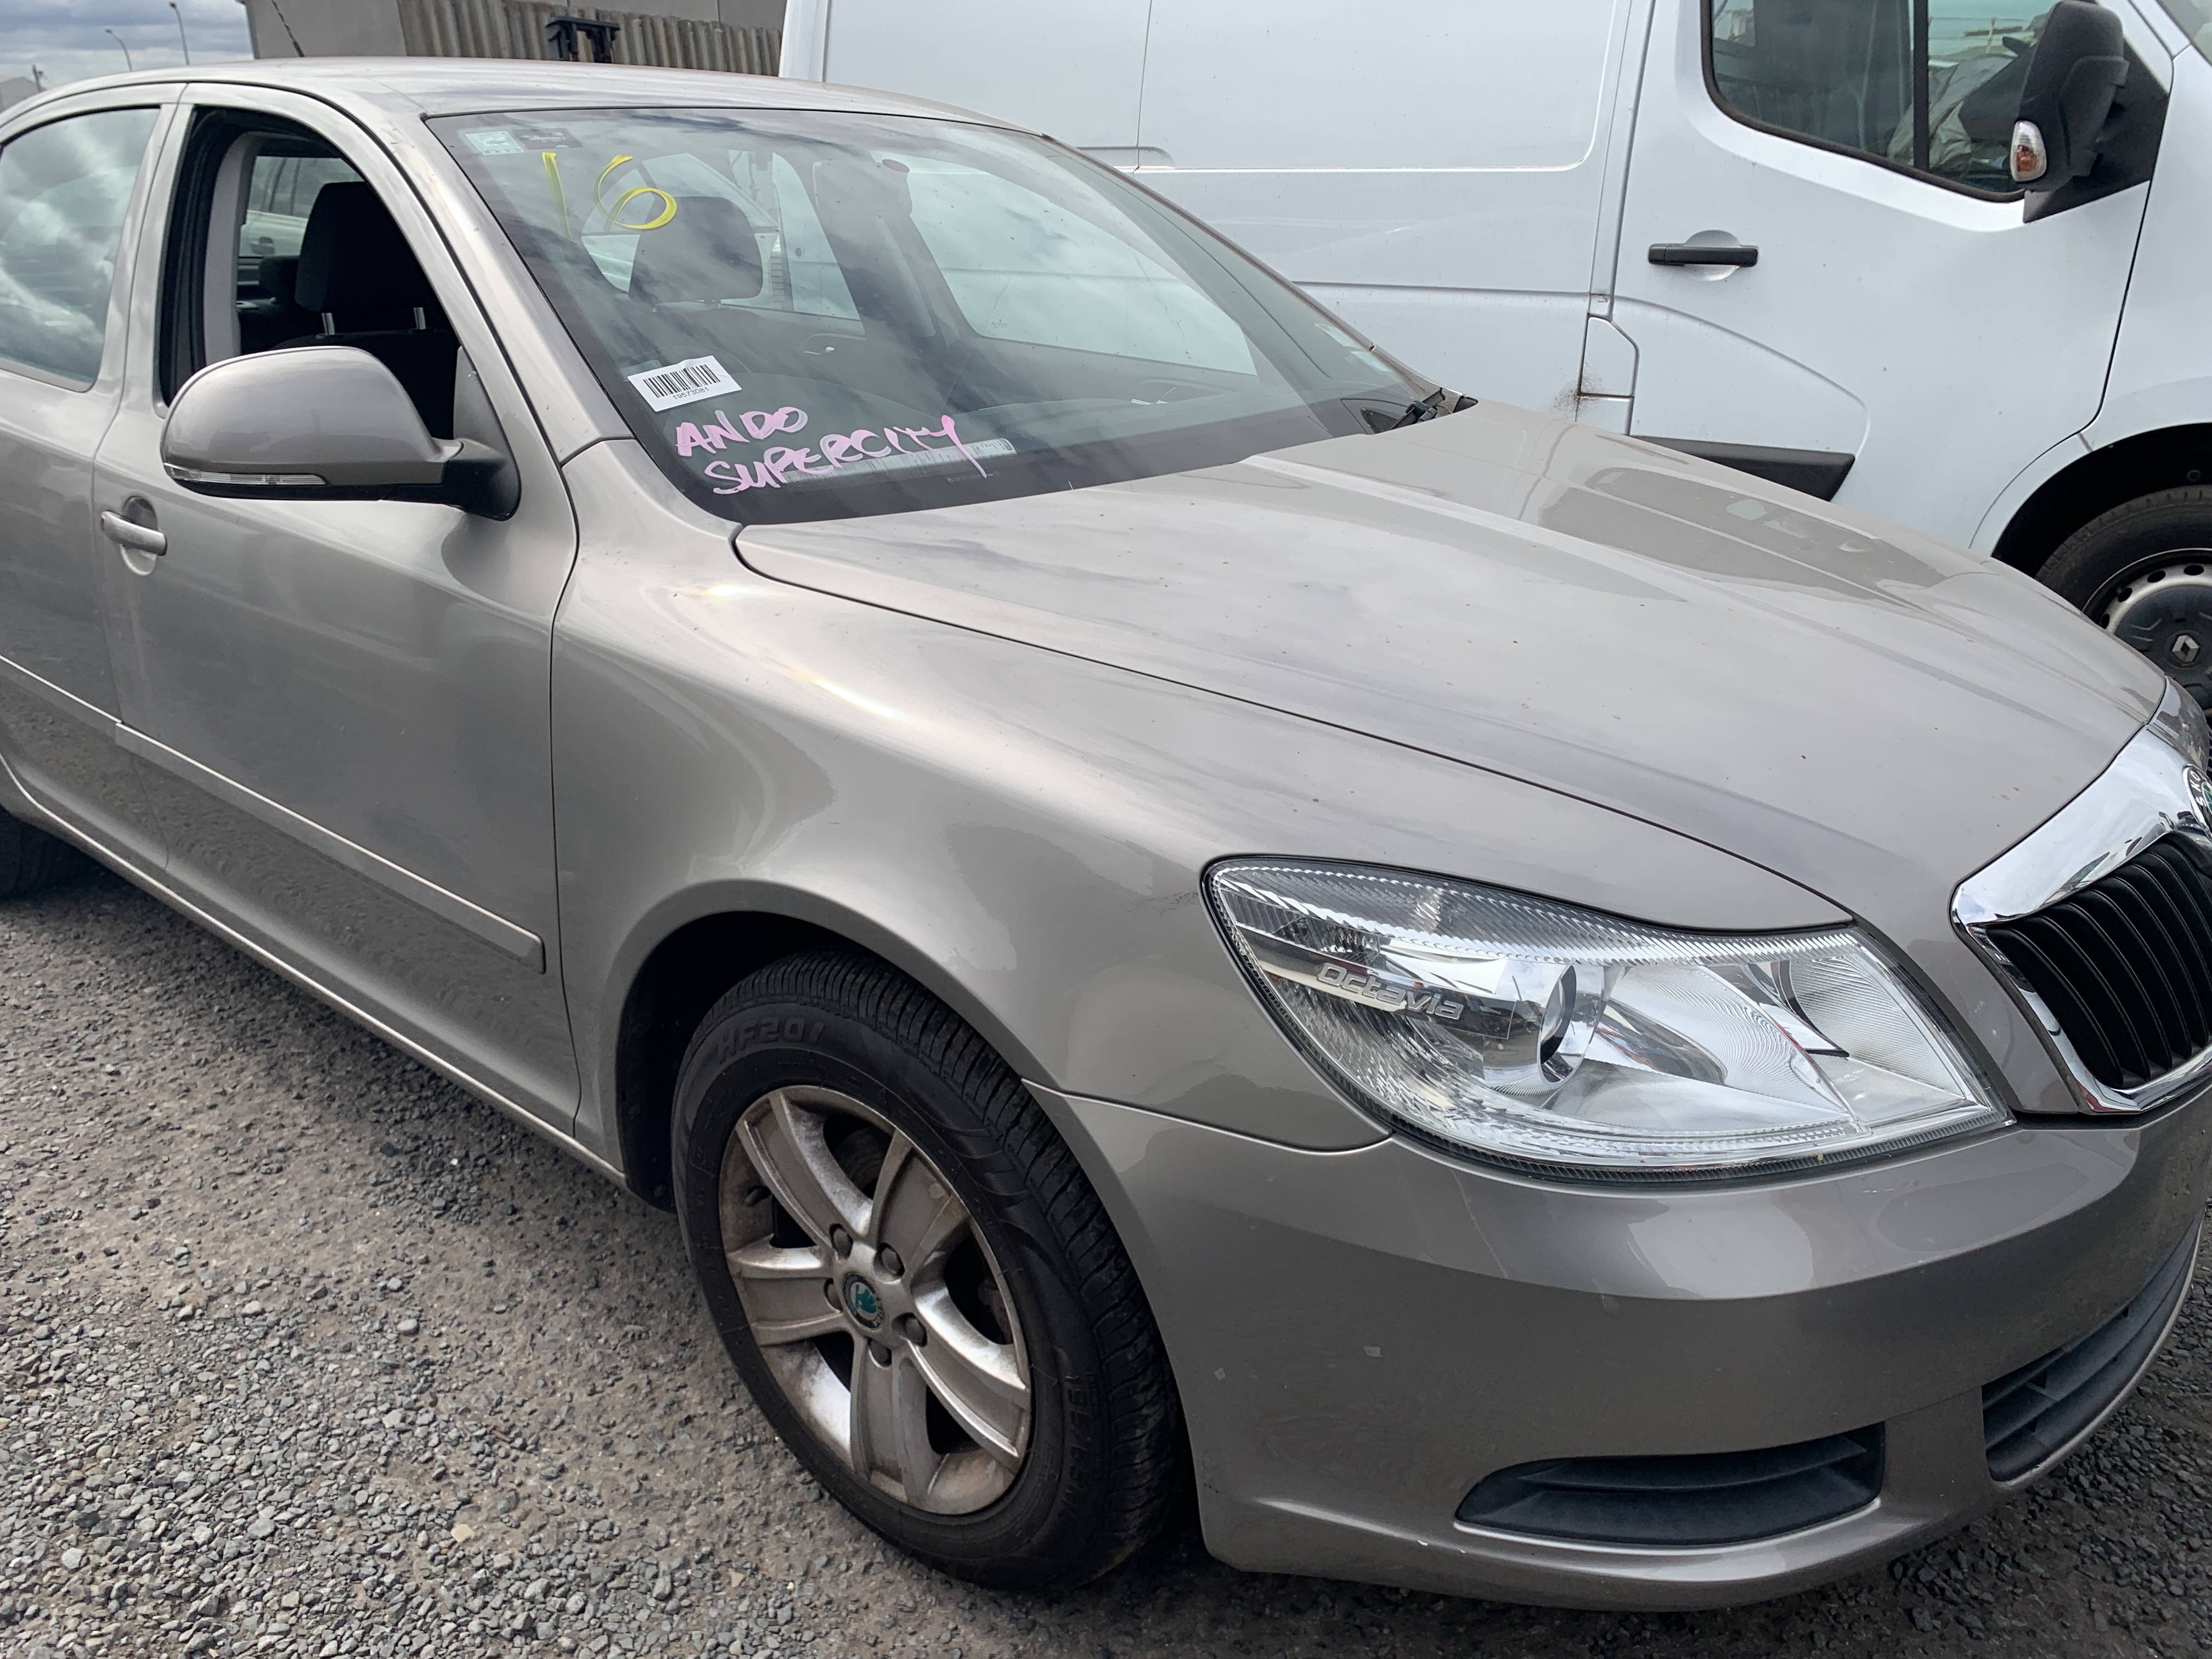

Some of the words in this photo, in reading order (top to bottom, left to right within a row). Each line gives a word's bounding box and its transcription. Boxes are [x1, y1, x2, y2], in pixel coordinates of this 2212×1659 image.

[541, 151, 678, 242] 16
[672, 386, 710, 400] 19573081
[675, 407, 808, 456] ANDO
[704, 415, 986, 494] SUPERCITY
[1316, 962, 1466, 1020] Octavia
[717, 1016, 826, 1064] HF201
